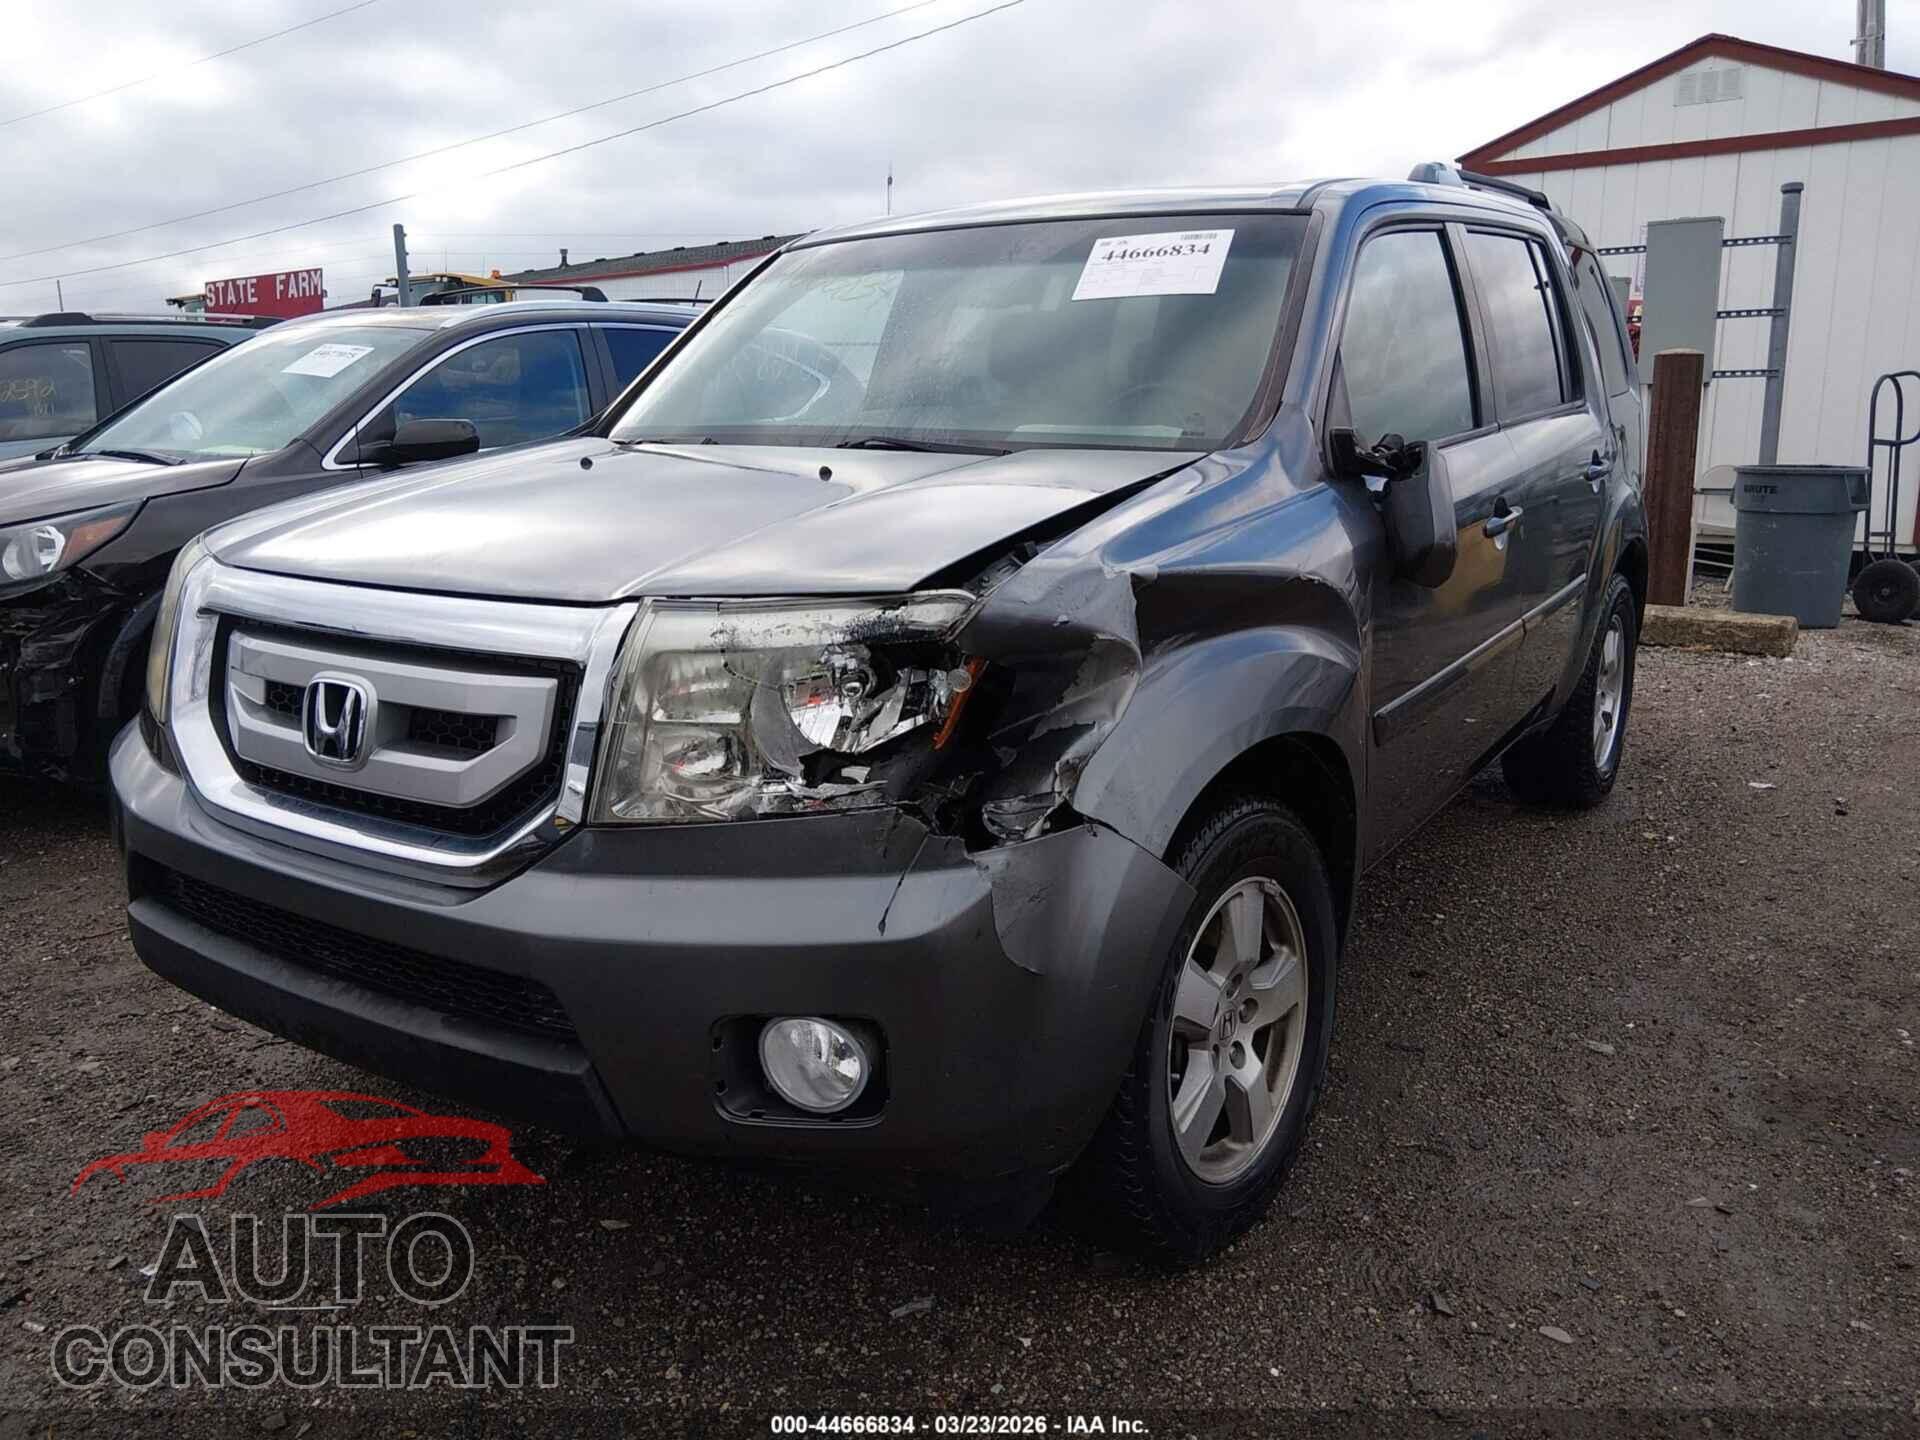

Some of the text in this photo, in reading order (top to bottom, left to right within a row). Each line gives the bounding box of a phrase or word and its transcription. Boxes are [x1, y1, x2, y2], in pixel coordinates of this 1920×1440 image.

[1101, 242, 1211, 262] 44666834
[206, 270, 322, 308] STATE FARM
